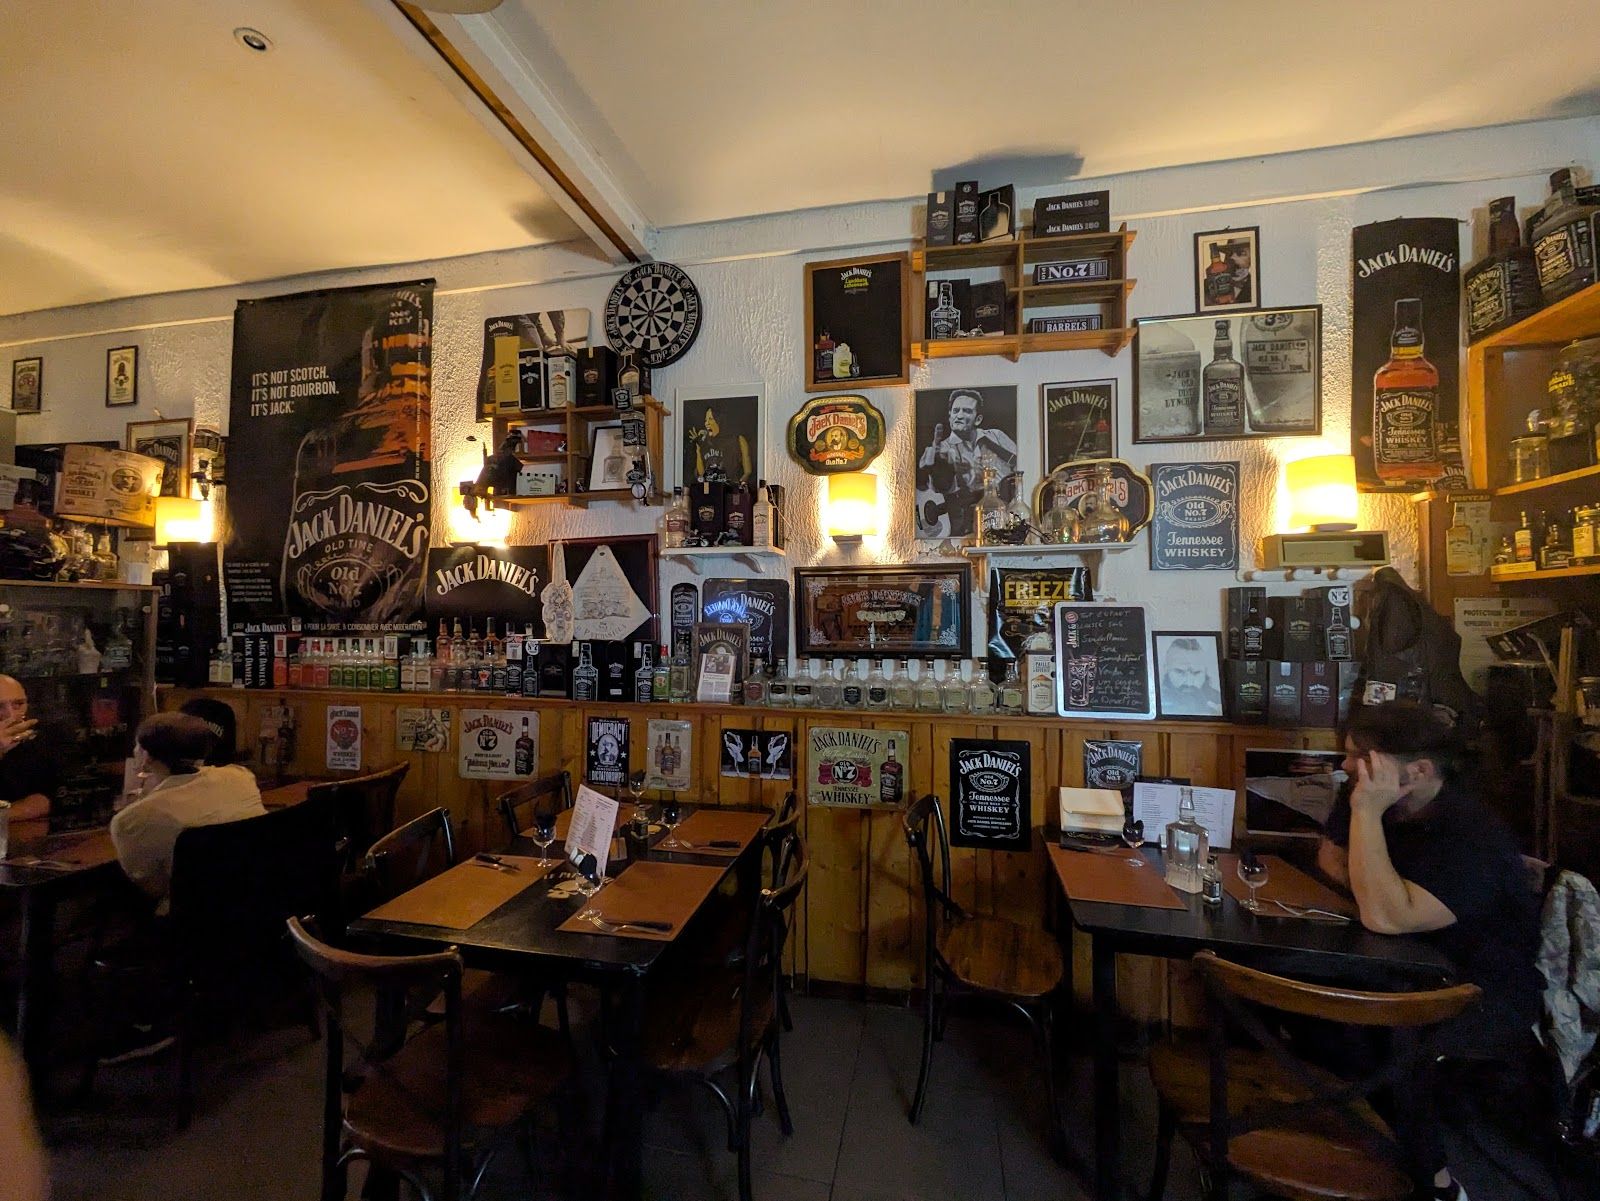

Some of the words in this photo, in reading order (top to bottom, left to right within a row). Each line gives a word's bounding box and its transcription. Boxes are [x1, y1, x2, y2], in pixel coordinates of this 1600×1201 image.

[1046, 202, 1061, 212] JACK
[1061, 200, 1083, 210] DANIEL'S
[1046, 224, 1061, 233] JACK
[1061, 222, 1083, 231] DANIEL'S
[1358, 250, 1398, 278] JACK
[1398, 244, 1456, 273] DANIEL'S
[840, 269, 853, 281] JACK
[1048, 263, 1088, 279] No.7
[1047, 321, 1087, 333] BARRELS
[252, 372, 268, 387] IT'S
[270, 370, 288, 385] NOT
[290, 366, 329, 382] SCOTCH.
[252, 388, 268, 402] IT'S
[270, 385, 288, 400] NOT
[290, 381, 339, 398] BOURBON.
[251, 403, 268, 417] IT'S
[1049, 396, 1073, 414] JACK
[1072, 390, 1110, 411] DANIEL'S
[1381, 398, 1402, 413] JACK
[1402, 394, 1433, 412] DANIEL'S
[1387, 426, 1426, 436] Tennessee
[1160, 473, 1187, 496] JACK
[1187, 470, 1233, 495] DANIEL'S
[1186, 502, 1205, 510] Old
[288, 505, 338, 559] JACK
[339, 494, 430, 559] DANIEL'S
[324, 539, 344, 553] OLD
[348, 539, 374, 552] TIME
[1167, 532, 1224, 546] Tennessee
[1164, 548, 1227, 558] WHISKEY
[330, 566, 360, 582] Old
[436, 561, 475, 596] JACK
[477, 554, 540, 598] DANIEL'S
[1004, 580, 1075, 600] FREEZE
[741, 593, 776, 616] DANIEL'S
[245, 622, 261, 633] JACK
[700, 631, 716, 647] JACK
[464, 718, 482, 733] JACK
[482, 715, 514, 735] DANIEL'S
[813, 732, 838, 752] JACK
[838, 732, 881, 754] DANIEL'S
[1090, 747, 1108, 766] JACK
[1107, 746, 1137, 767] DANIEL'S
[959, 757, 983, 774] JACK
[983, 753, 1022, 778] DANIEL'S
[820, 790, 871, 805] WHISKEY
[969, 791, 1011, 803] Tennessee
[969, 805, 1010, 814] WHISKEY
